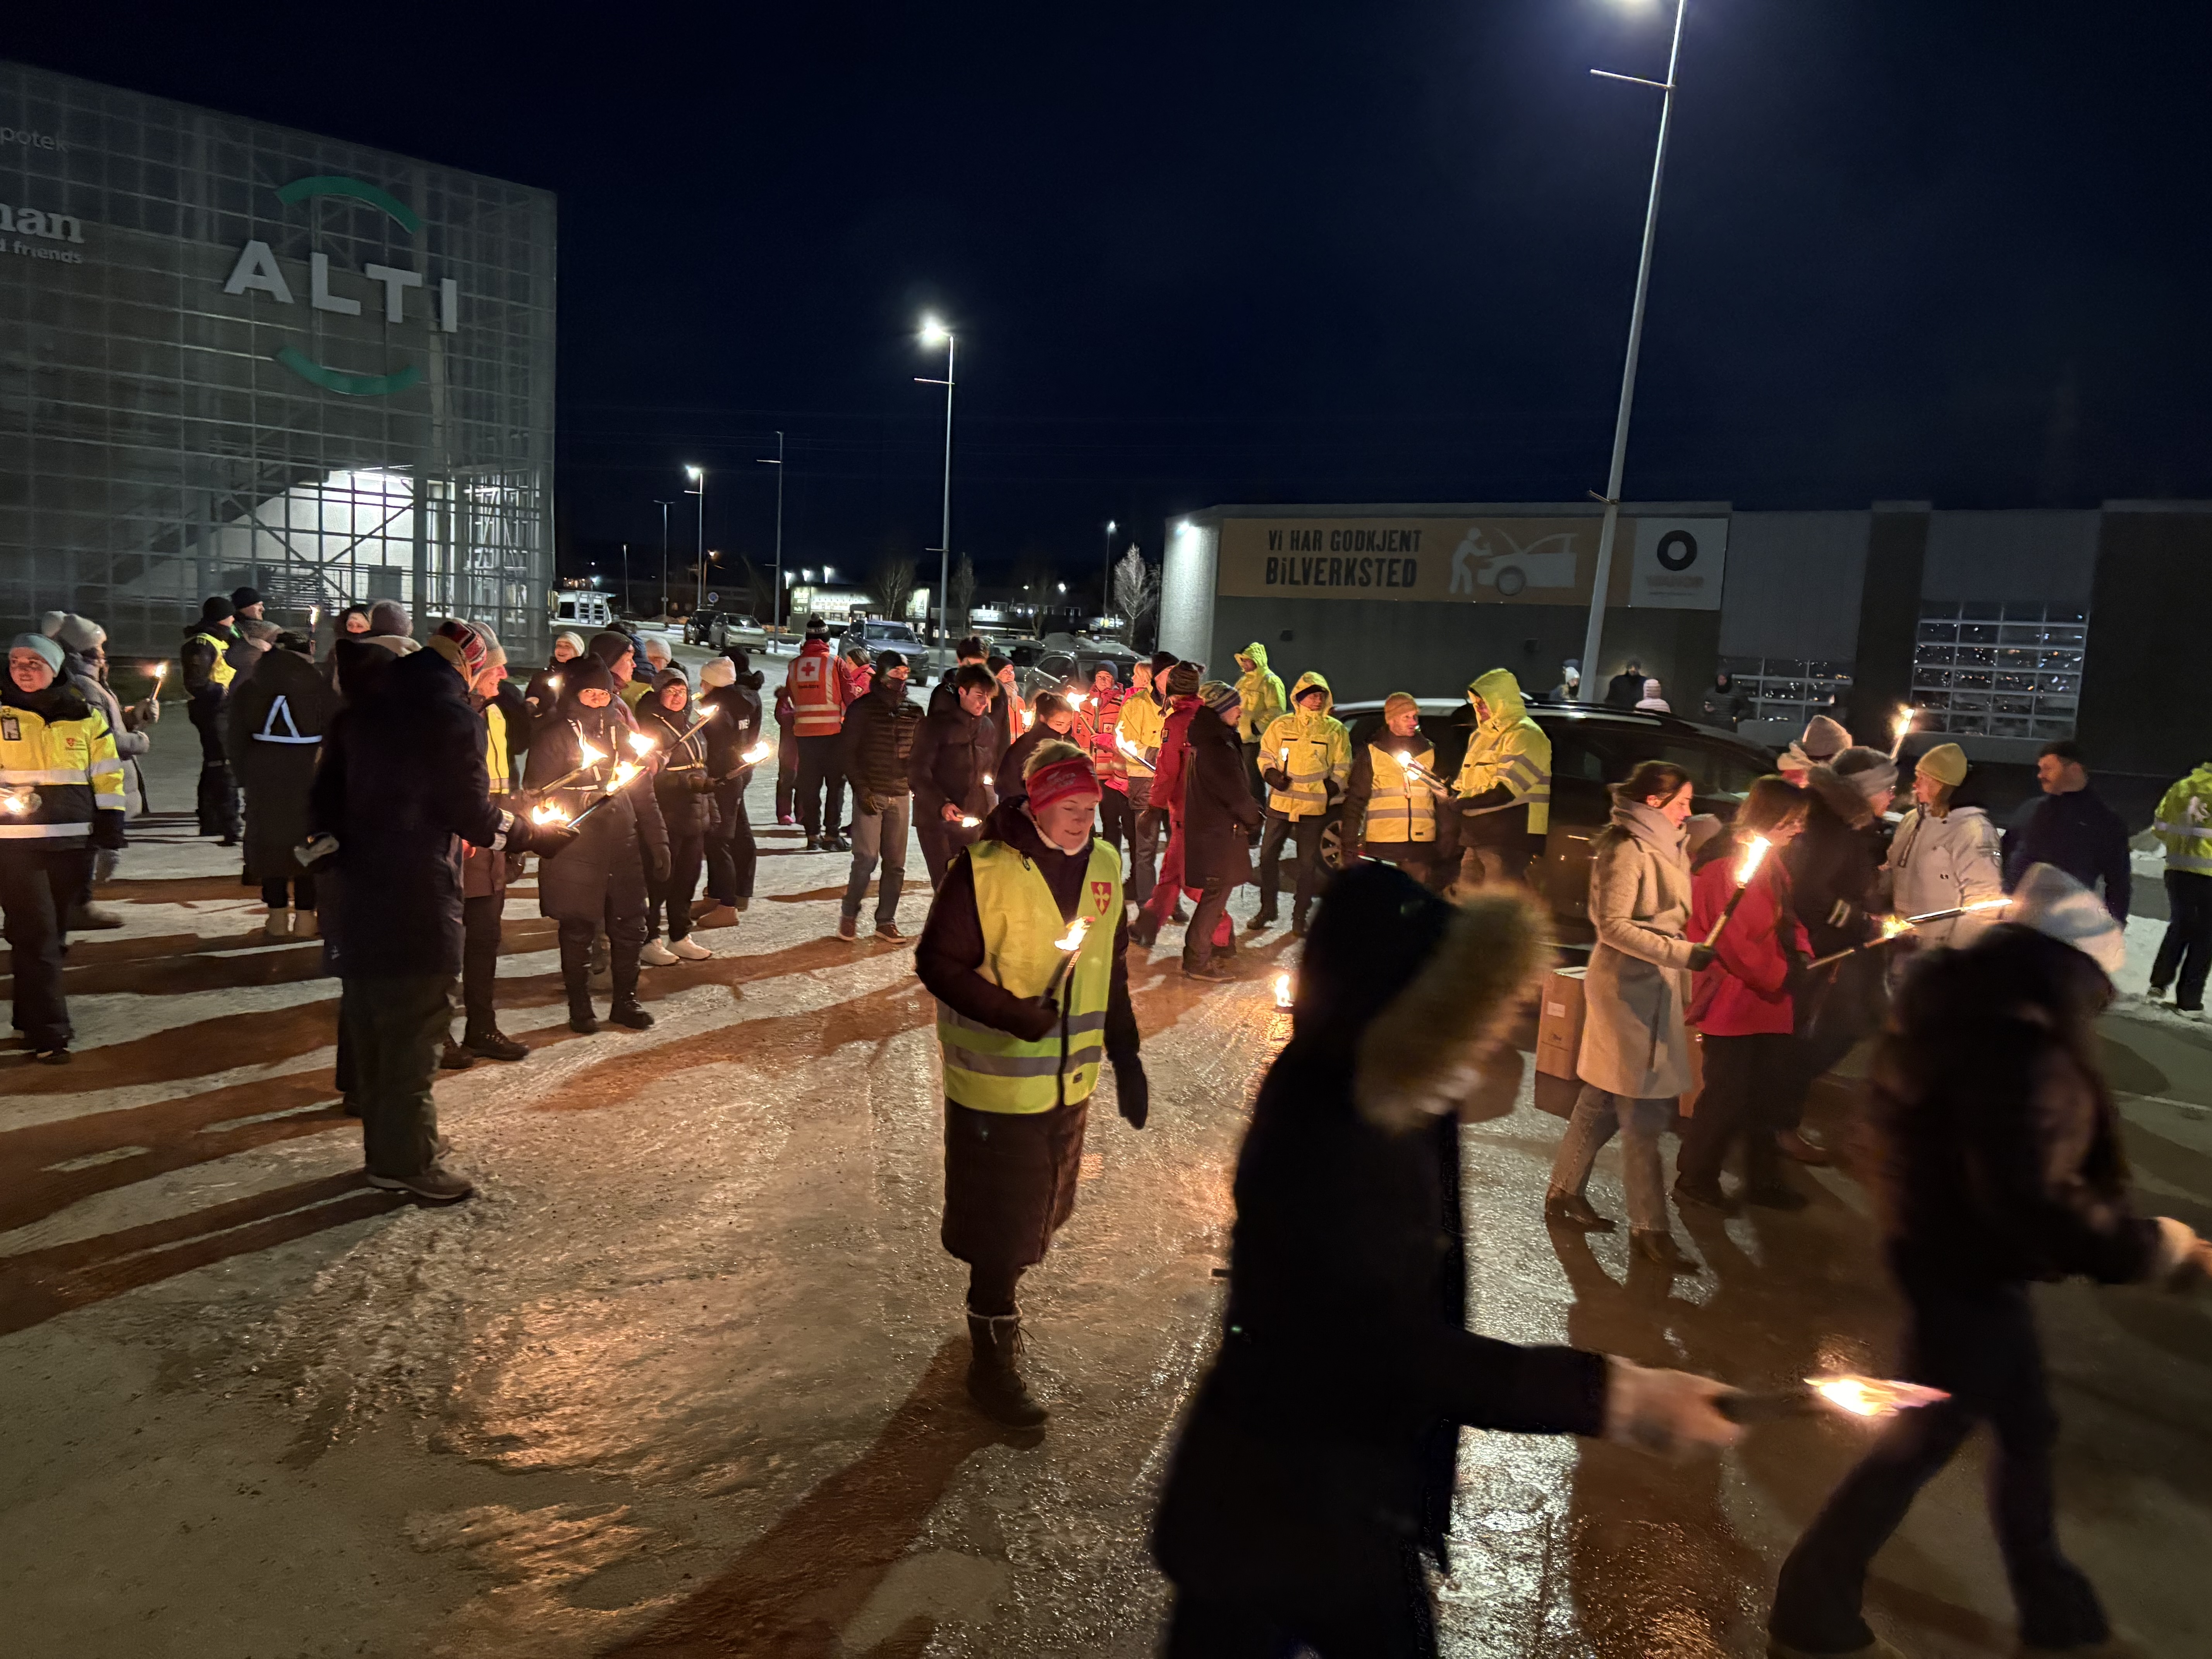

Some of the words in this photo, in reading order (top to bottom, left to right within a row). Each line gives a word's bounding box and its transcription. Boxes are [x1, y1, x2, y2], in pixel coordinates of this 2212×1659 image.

[223, 240, 457, 333] ALTI
[1290, 529, 1323, 552] HAR
[1330, 529, 1422, 552] GODKJENT
